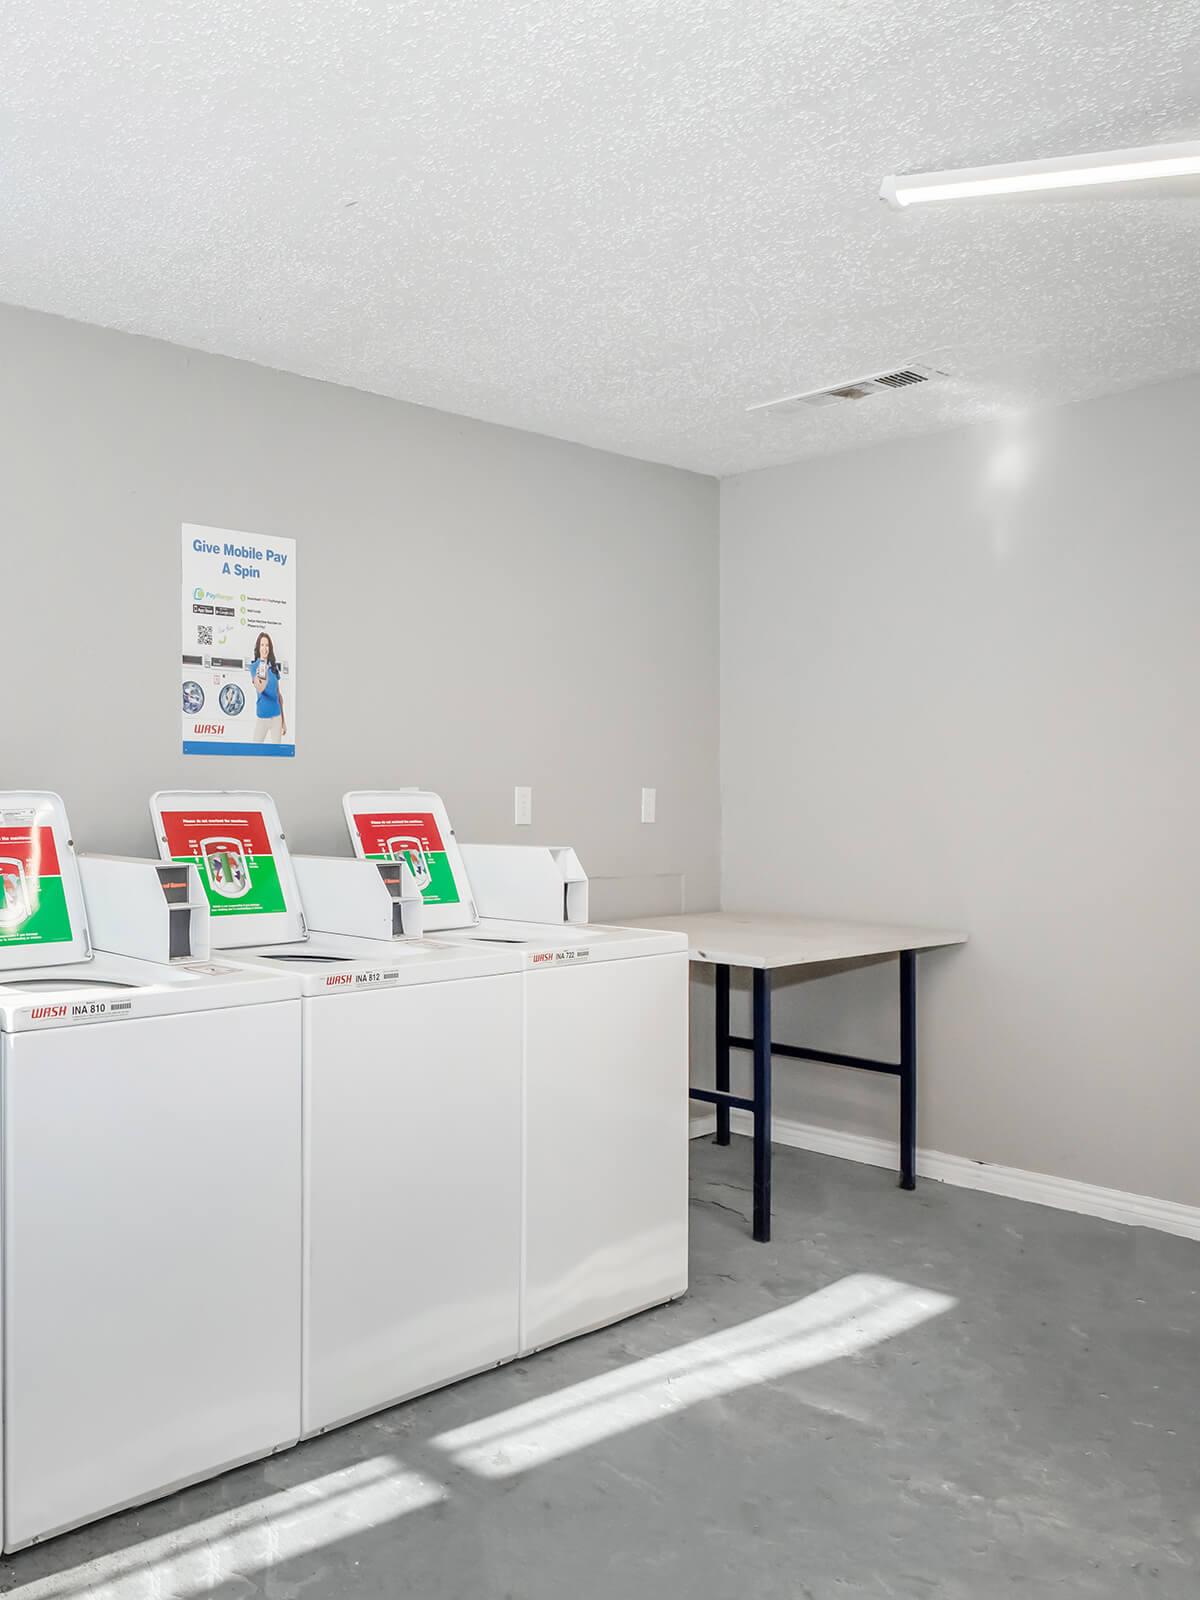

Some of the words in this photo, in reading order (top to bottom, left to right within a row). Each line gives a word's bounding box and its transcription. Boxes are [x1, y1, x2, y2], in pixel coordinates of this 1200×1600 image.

[192, 539, 220, 554] Give
[223, 543, 263, 560] Mobile
[266, 549, 287, 566] Pay
[222, 562, 231, 575] A
[234, 563, 260, 579] Spin
[194, 724, 225, 734] WASH
[533, 952, 554, 962] WASH
[556, 952, 565, 960] INA
[326, 974, 352, 985] WASH
[355, 975, 367, 983] INA
[368, 973, 380, 982] 812
[31, 1005, 68, 1019] WASH
[72, 1006, 87, 1015] INA
[90, 1003, 106, 1013] 810
